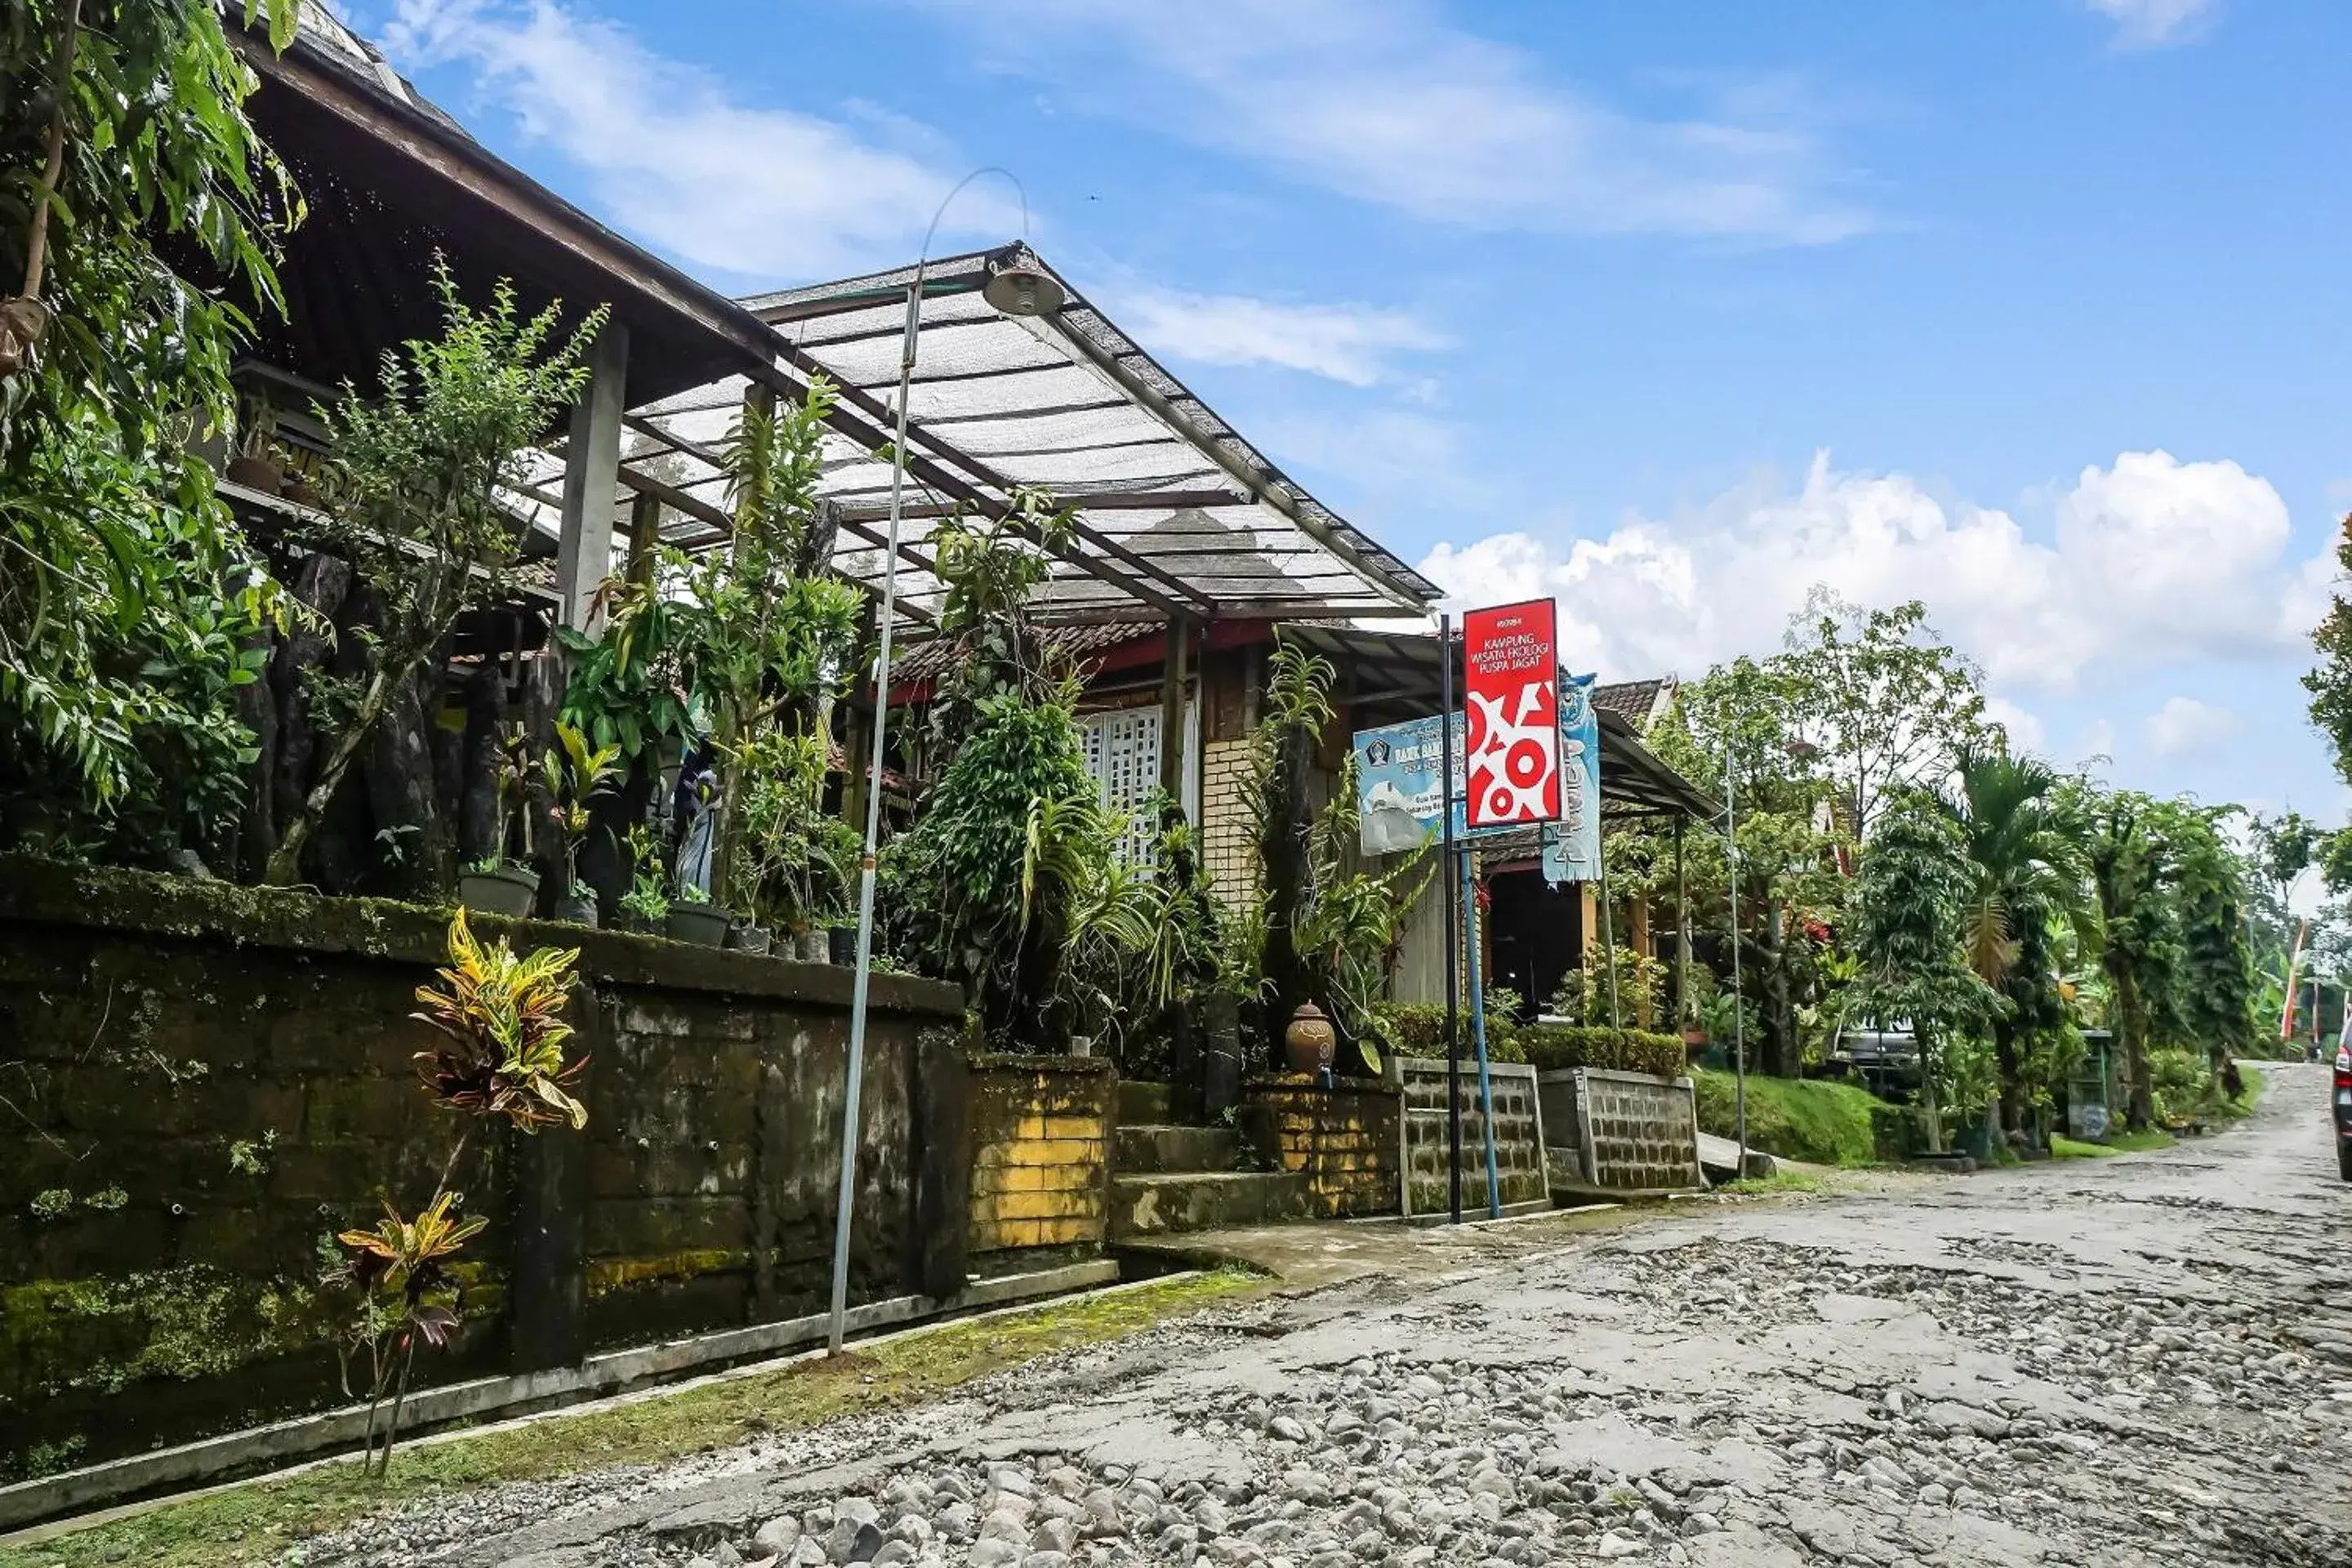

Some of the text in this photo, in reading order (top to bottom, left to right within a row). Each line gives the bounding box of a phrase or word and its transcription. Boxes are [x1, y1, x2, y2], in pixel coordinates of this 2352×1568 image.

[1484, 633, 1535, 651] KAMPUNG
[1471, 642, 1548, 664] WISATA EKOLOGI
[1480, 655, 1541, 675] PUSPA JAGAT
